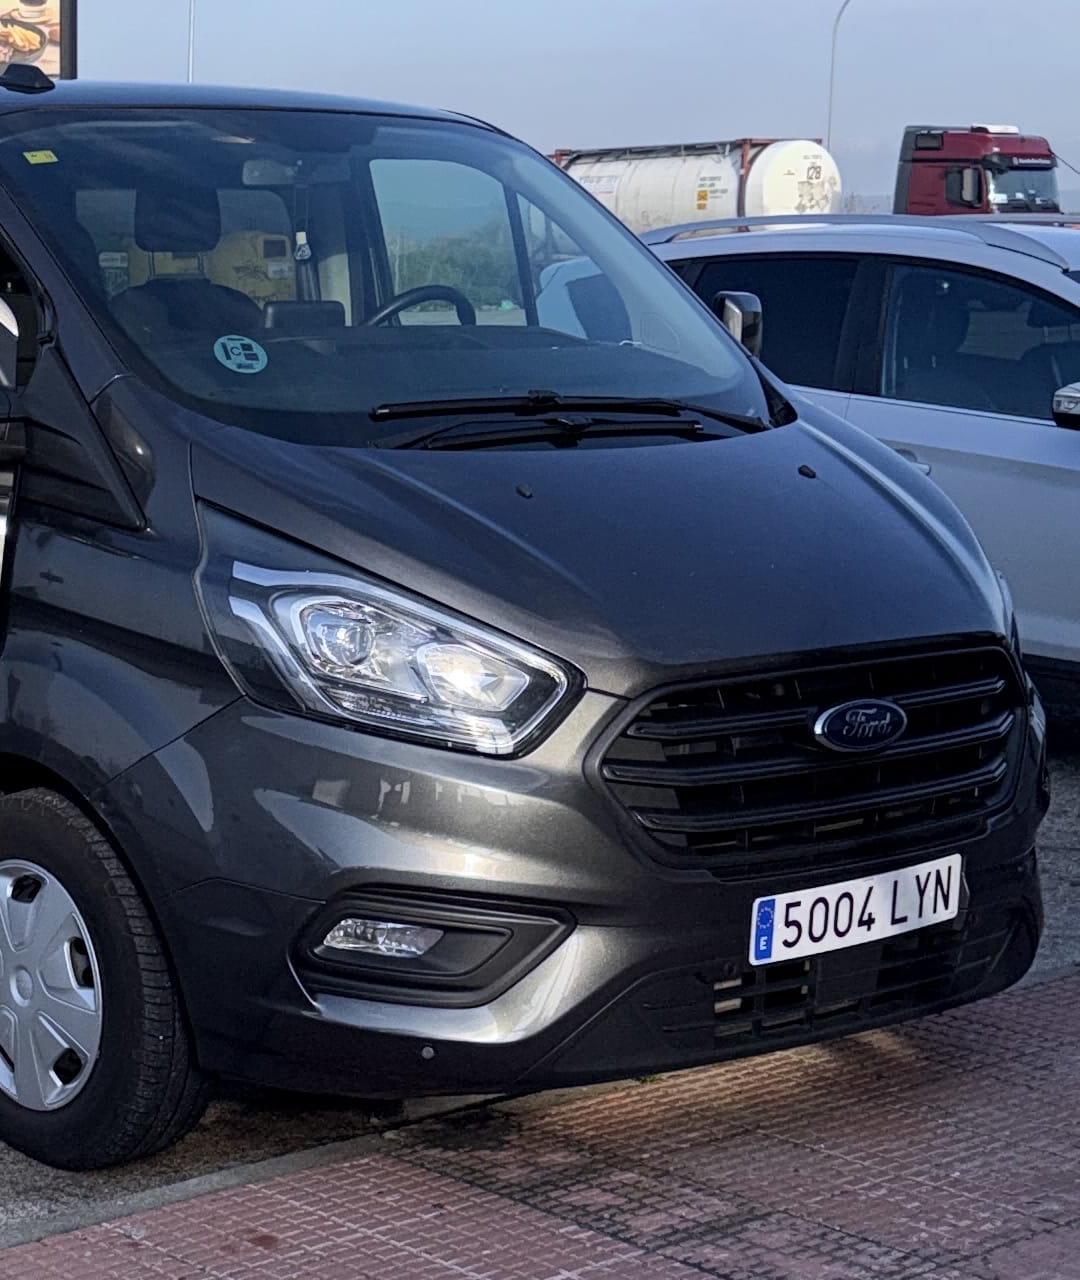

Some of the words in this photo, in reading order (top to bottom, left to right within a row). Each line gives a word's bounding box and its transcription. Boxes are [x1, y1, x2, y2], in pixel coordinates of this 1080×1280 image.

[843, 708, 892, 737] Ford
[782, 886, 875, 948] 5004
[890, 865, 952, 926] LYN
[759, 936, 768, 951] E
